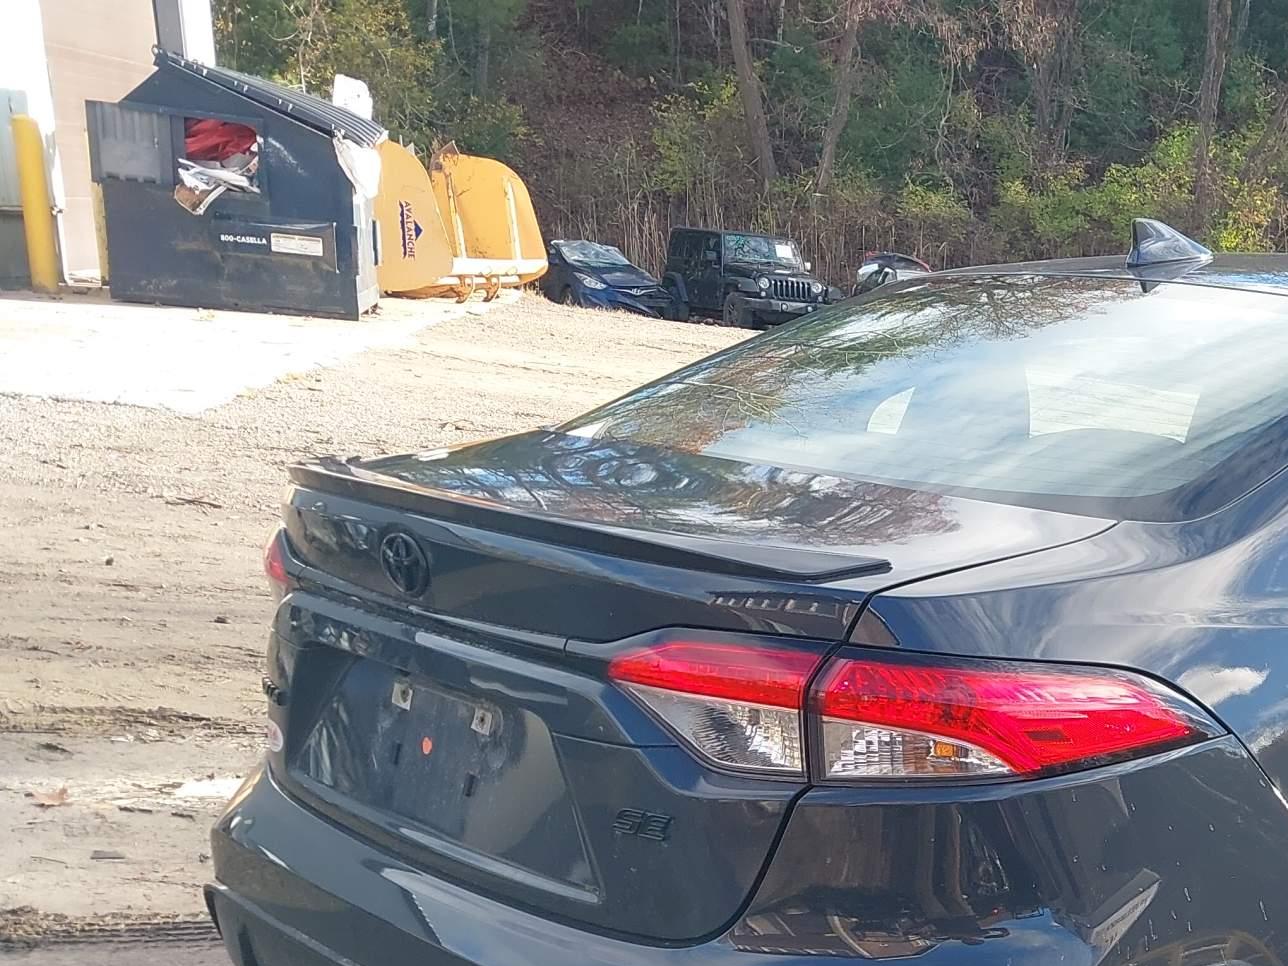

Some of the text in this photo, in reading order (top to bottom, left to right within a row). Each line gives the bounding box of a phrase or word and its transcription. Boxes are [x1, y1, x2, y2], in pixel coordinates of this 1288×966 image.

[220, 234, 267, 245] 800-CASELLA
[404, 200, 416, 261] AVALANCHE
[612, 807, 673, 841] SE
